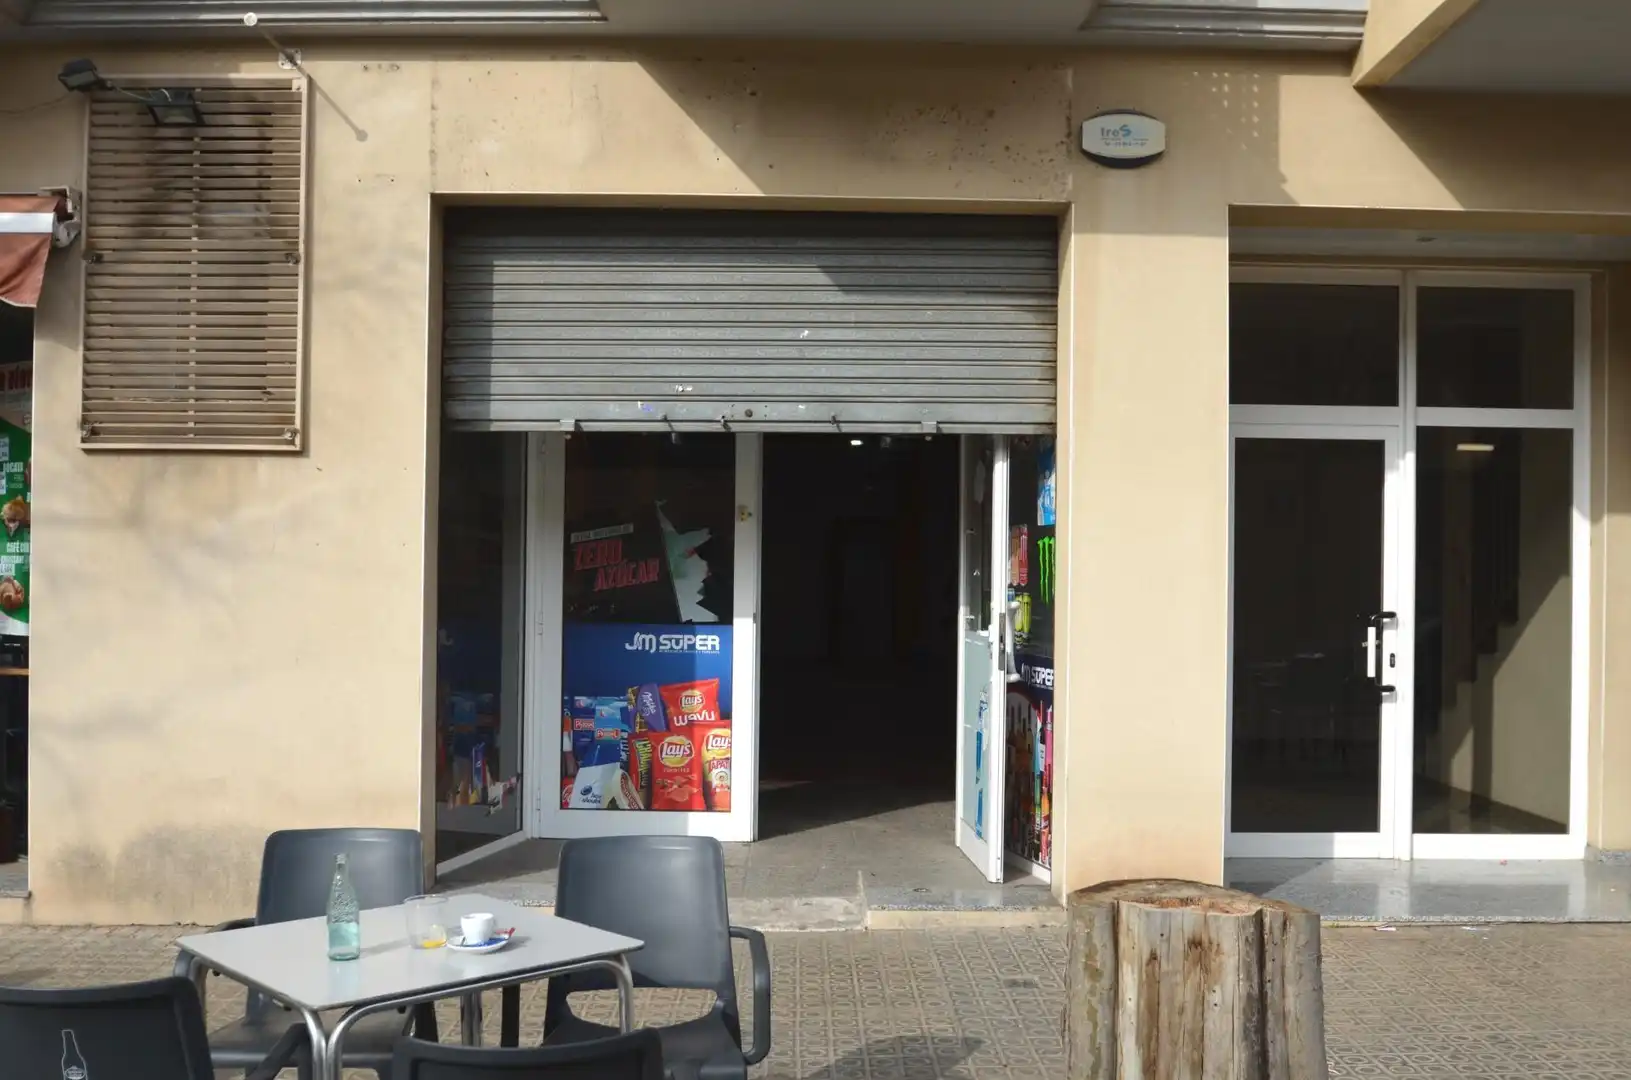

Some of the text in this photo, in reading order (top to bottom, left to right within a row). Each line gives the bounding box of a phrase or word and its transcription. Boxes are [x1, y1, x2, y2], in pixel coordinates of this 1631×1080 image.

[575, 539, 622, 571] ZERO
[625, 632, 720, 653] JM SUPER
